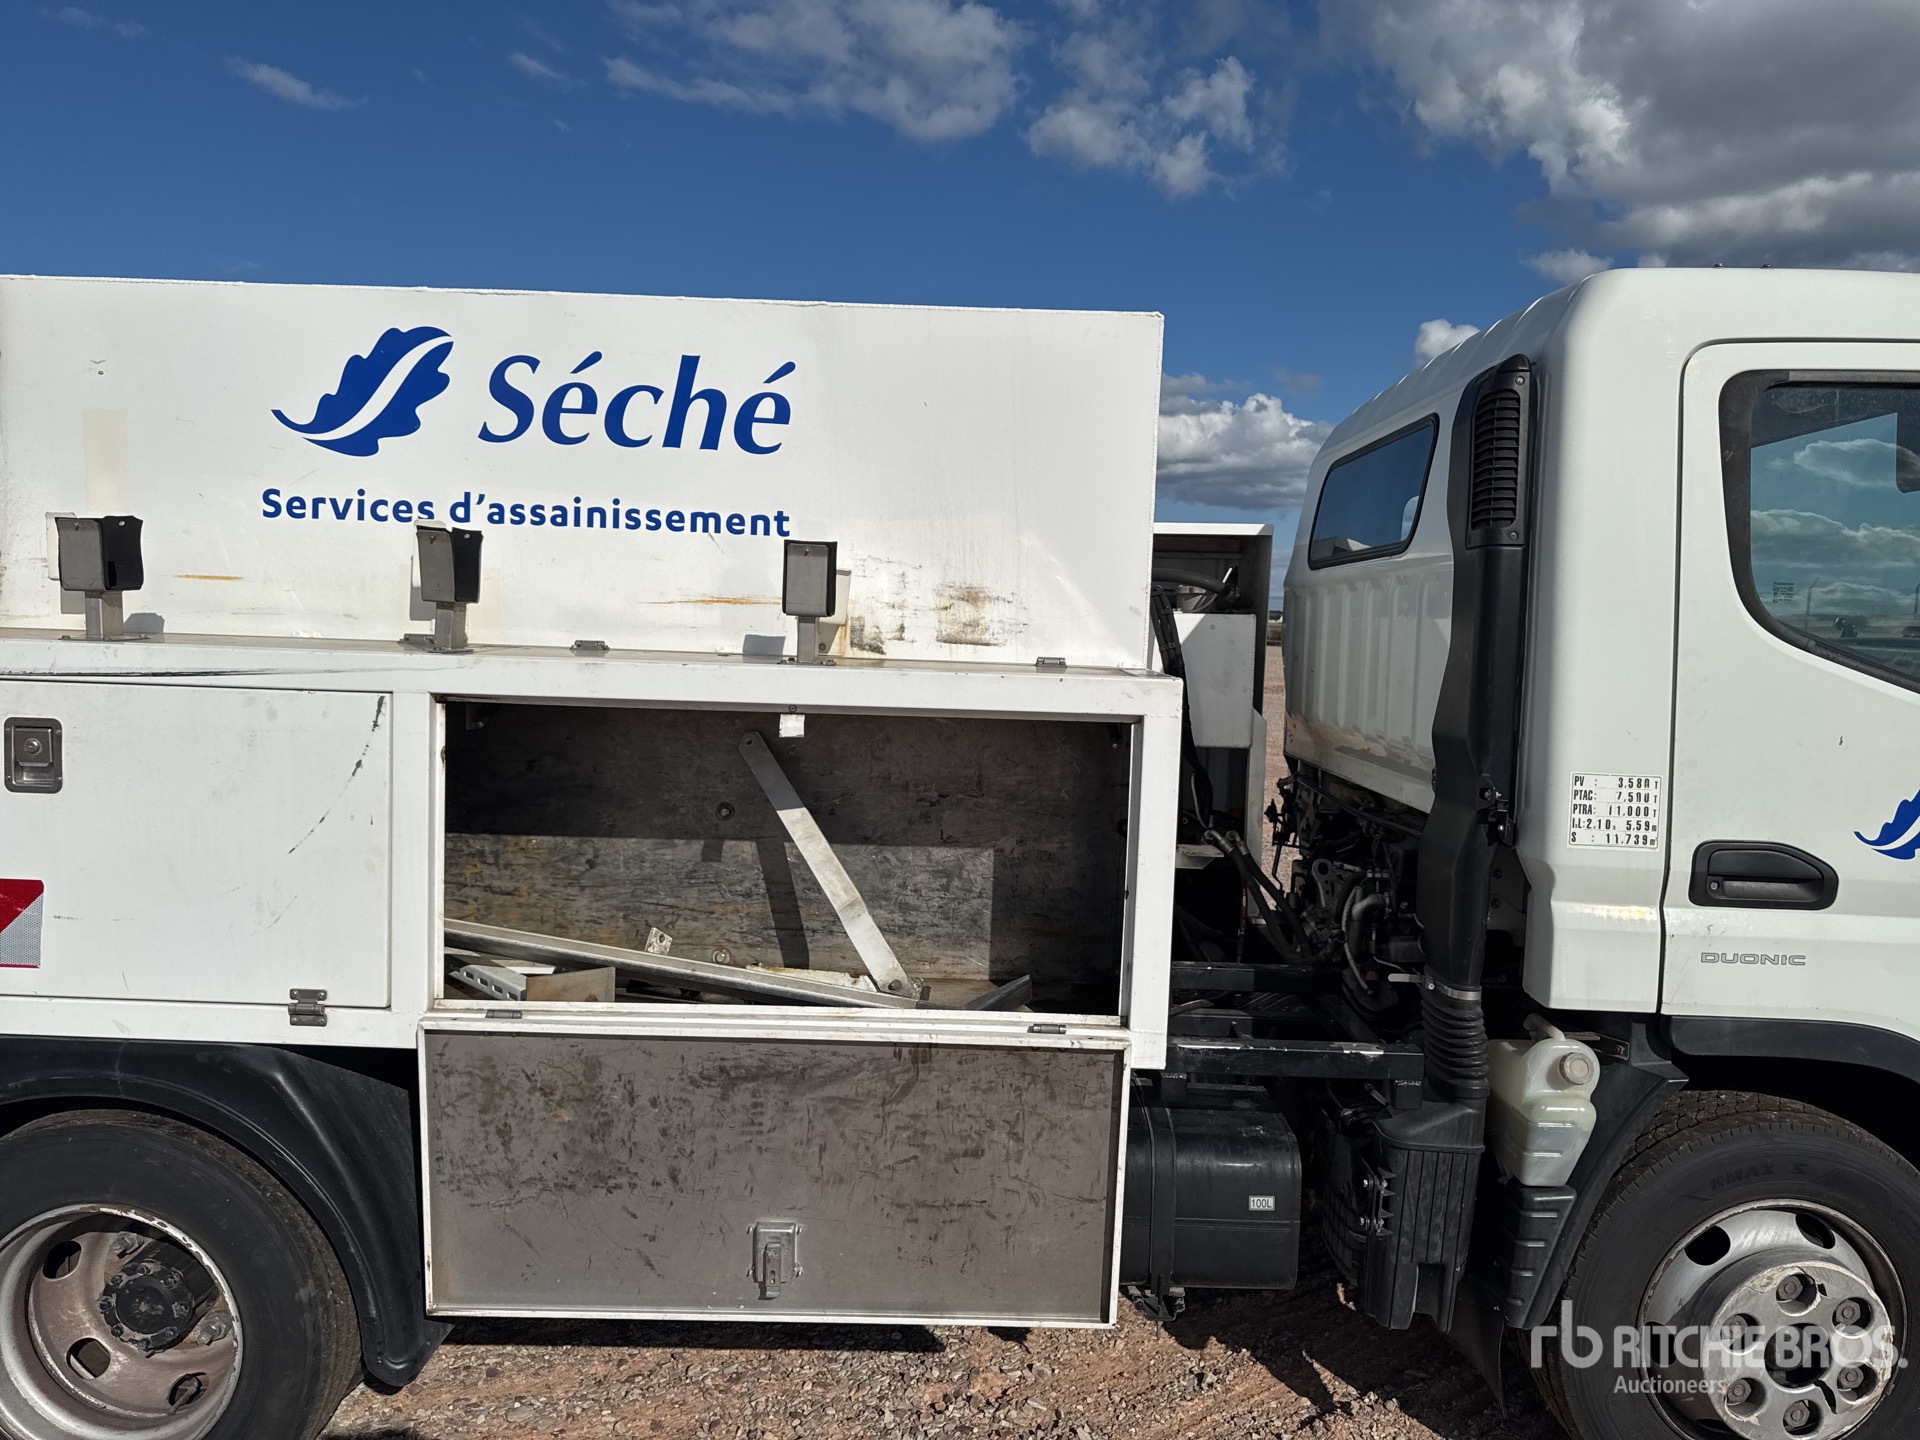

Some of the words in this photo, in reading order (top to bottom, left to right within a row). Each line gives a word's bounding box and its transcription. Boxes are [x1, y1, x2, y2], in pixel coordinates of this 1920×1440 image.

[477, 350, 798, 455] Séché
[262, 489, 435, 523] Services
[1574, 775, 1585, 787] PV
[1571, 832, 1577, 843] S
[1700, 952, 1806, 966] DUONIC
[1251, 1198, 1272, 1208] 100L
